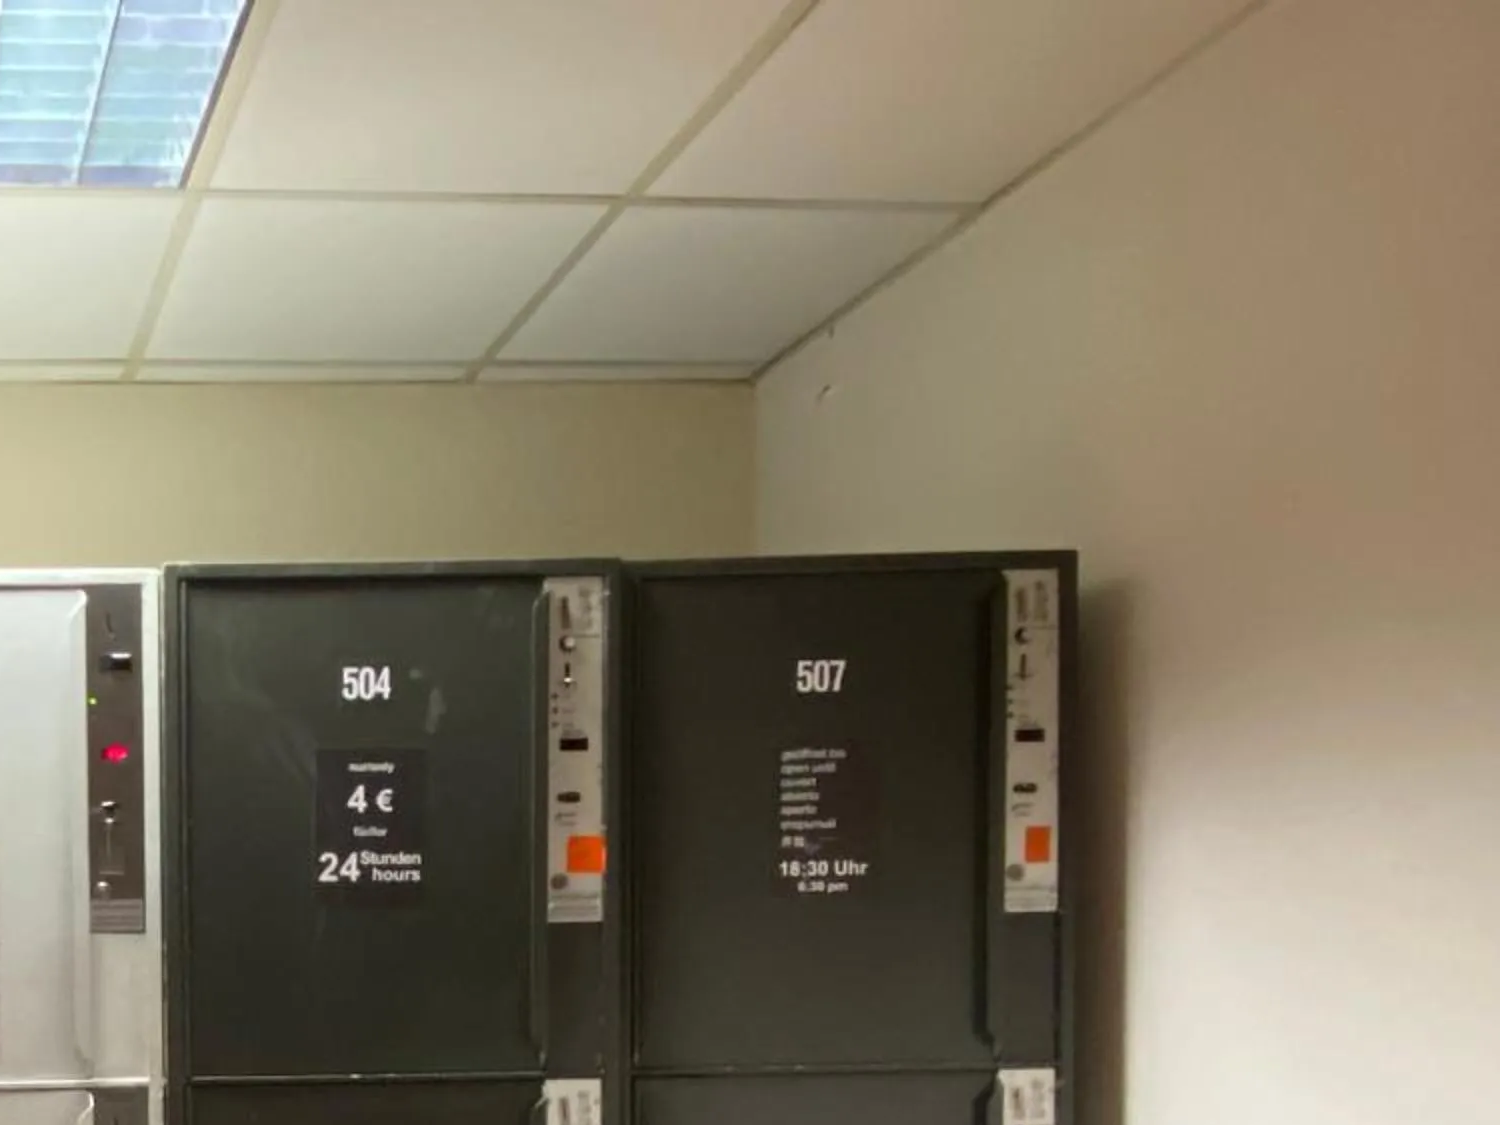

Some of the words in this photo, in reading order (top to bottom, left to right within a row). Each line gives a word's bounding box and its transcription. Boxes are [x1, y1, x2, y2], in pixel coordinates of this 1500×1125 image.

[341, 665, 392, 701] 504
[796, 659, 847, 693] 507
[347, 784, 368, 813] 4
[376, 788, 393, 812] €
[318, 852, 361, 882] 24
[361, 850, 422, 865] Stunden
[372, 867, 421, 882] hours
[780, 859, 829, 877] 18:30
[834, 859, 868, 876] Uhr
